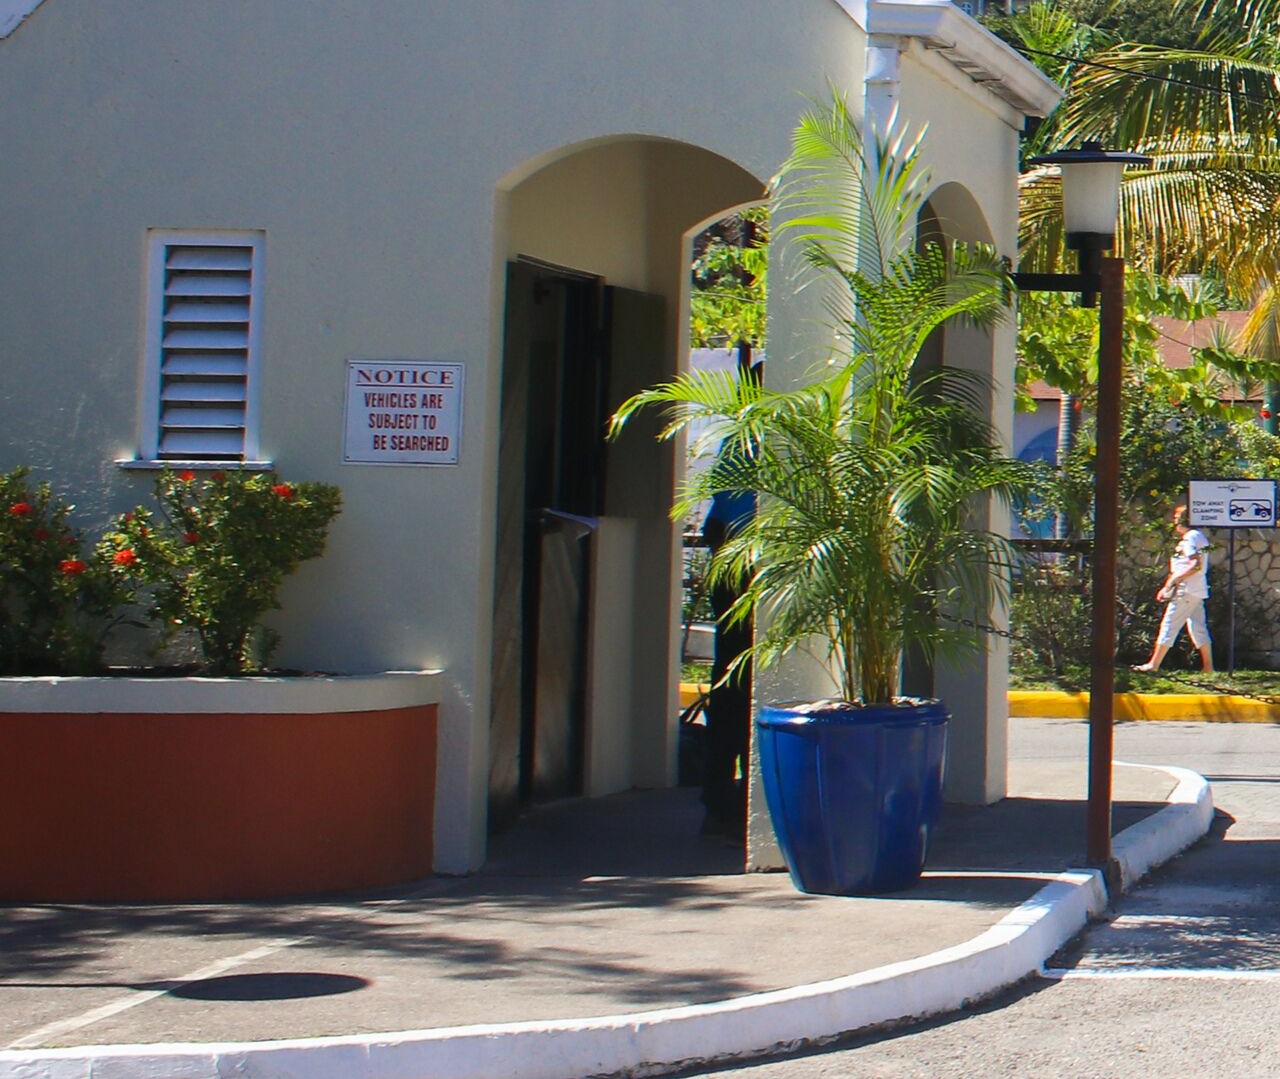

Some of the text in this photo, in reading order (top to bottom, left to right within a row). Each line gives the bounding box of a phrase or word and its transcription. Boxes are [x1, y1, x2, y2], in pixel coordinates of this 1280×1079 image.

[358, 370, 454, 384] NOTICE
[364, 392, 443, 409] VEHICLES ARE
[368, 413, 436, 430] SUBJECT TO
[373, 434, 449, 451] BE SEARCHED
